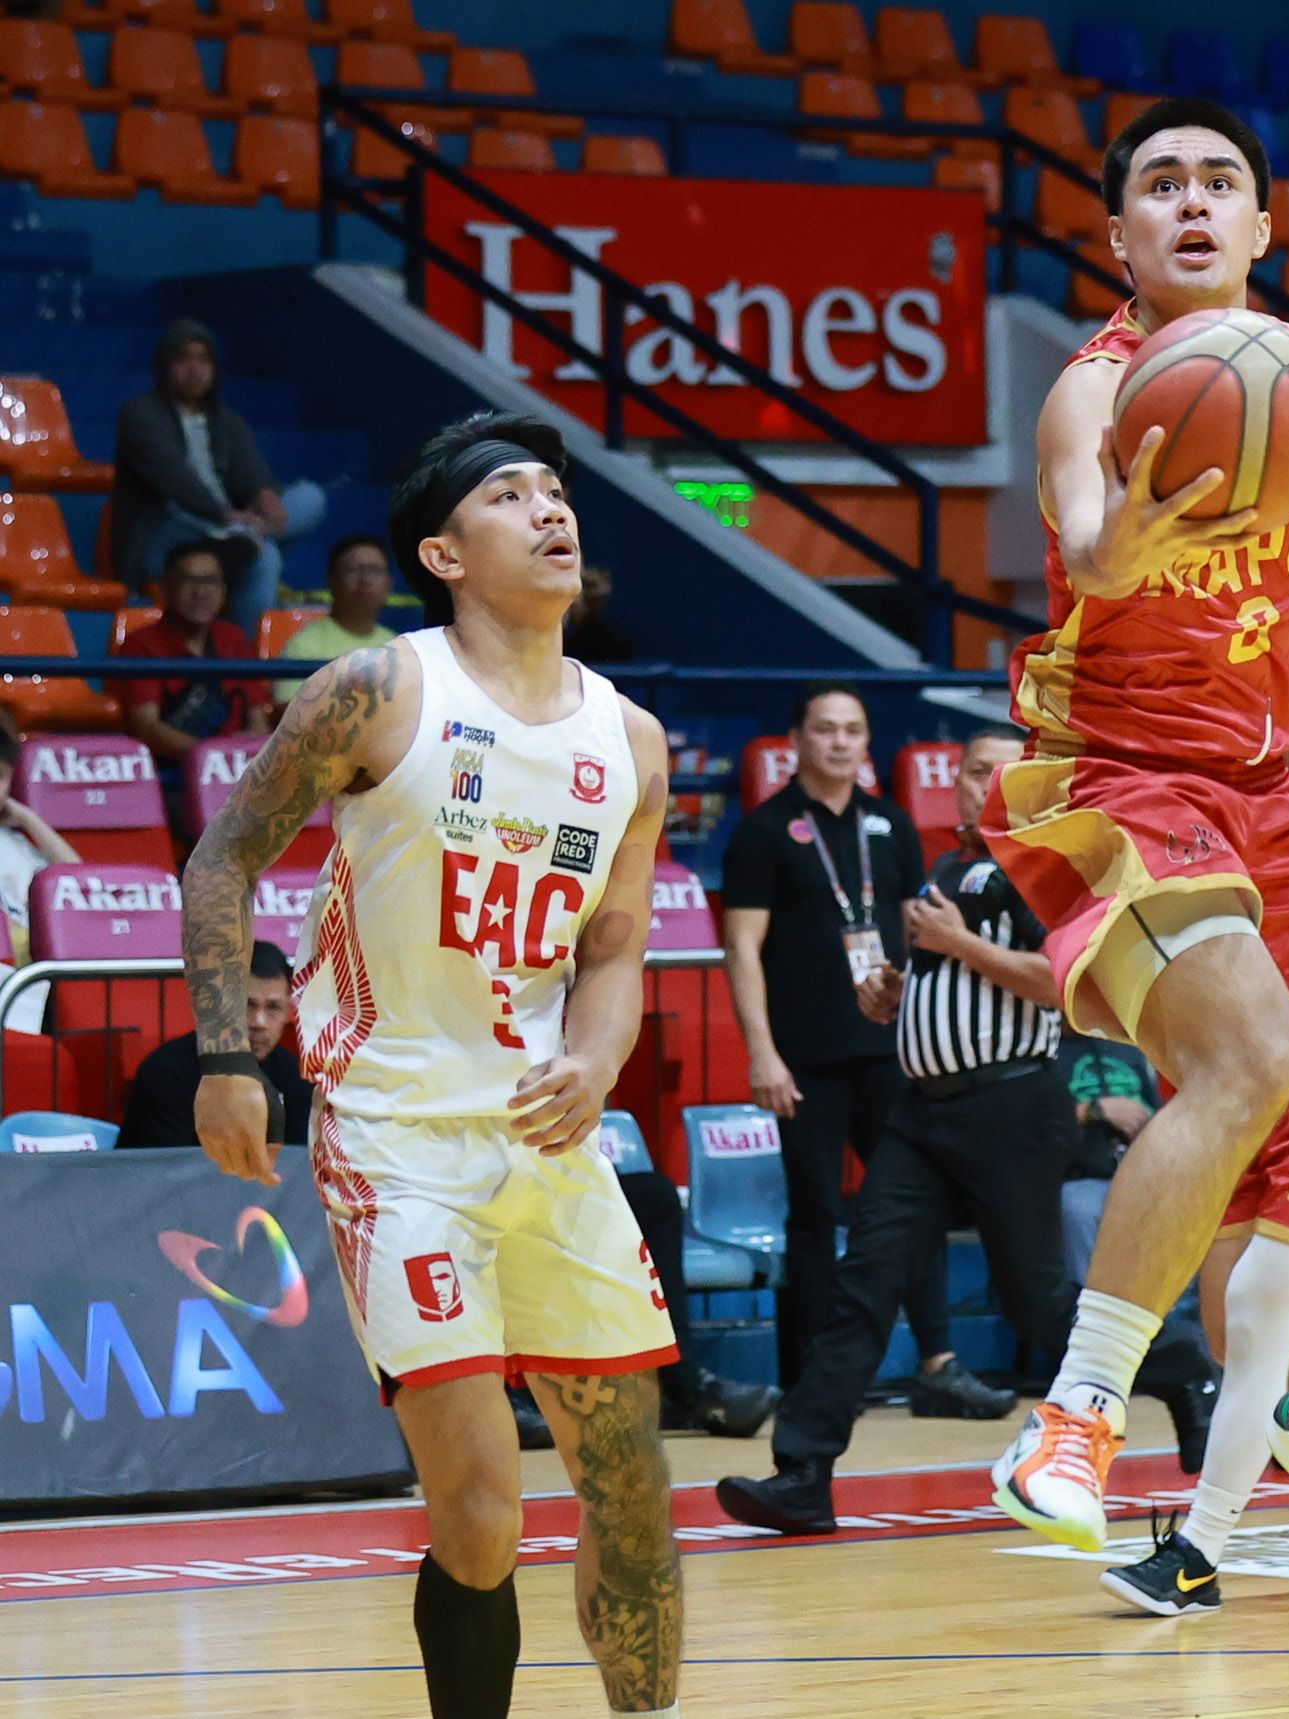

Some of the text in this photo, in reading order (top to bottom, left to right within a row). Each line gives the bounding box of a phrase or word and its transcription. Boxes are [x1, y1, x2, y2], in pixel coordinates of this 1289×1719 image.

[465, 221, 949, 393] Hanes
[31, 744, 155, 783] Akari
[450, 769, 483, 804] 100
[434, 806, 488, 831] Arbez
[446, 829, 474, 843] suites
[559, 828, 597, 848] CODE
[54, 873, 183, 911] Akari
[439, 849, 585, 969] EAC
[652, 872, 710, 910] ari
[491, 980, 526, 1049] 3
[0, 1299, 285, 1423] MA
